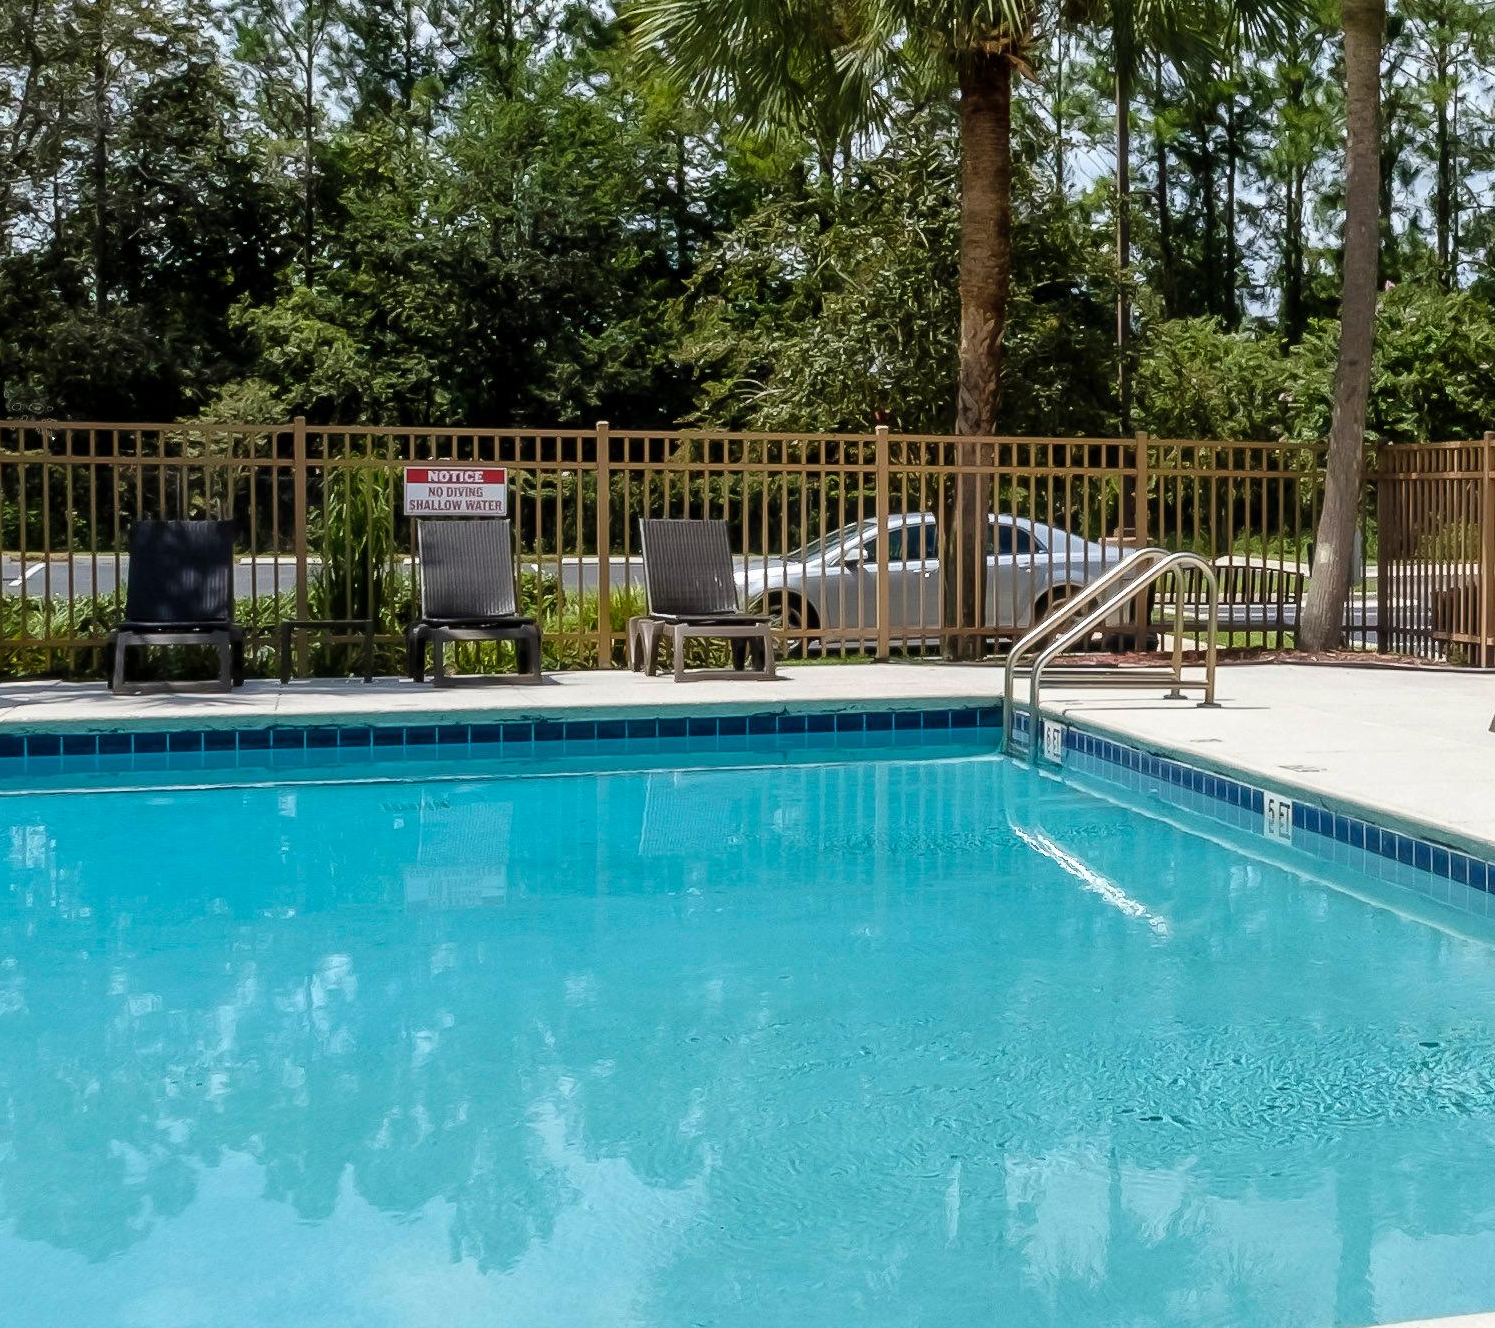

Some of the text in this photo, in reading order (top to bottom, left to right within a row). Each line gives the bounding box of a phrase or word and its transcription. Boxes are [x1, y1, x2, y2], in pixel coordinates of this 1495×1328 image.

[428, 471, 484, 482] NOTICE
[428, 487, 483, 497] NO DIVING
[409, 500, 502, 511] SHALLOW WATER
